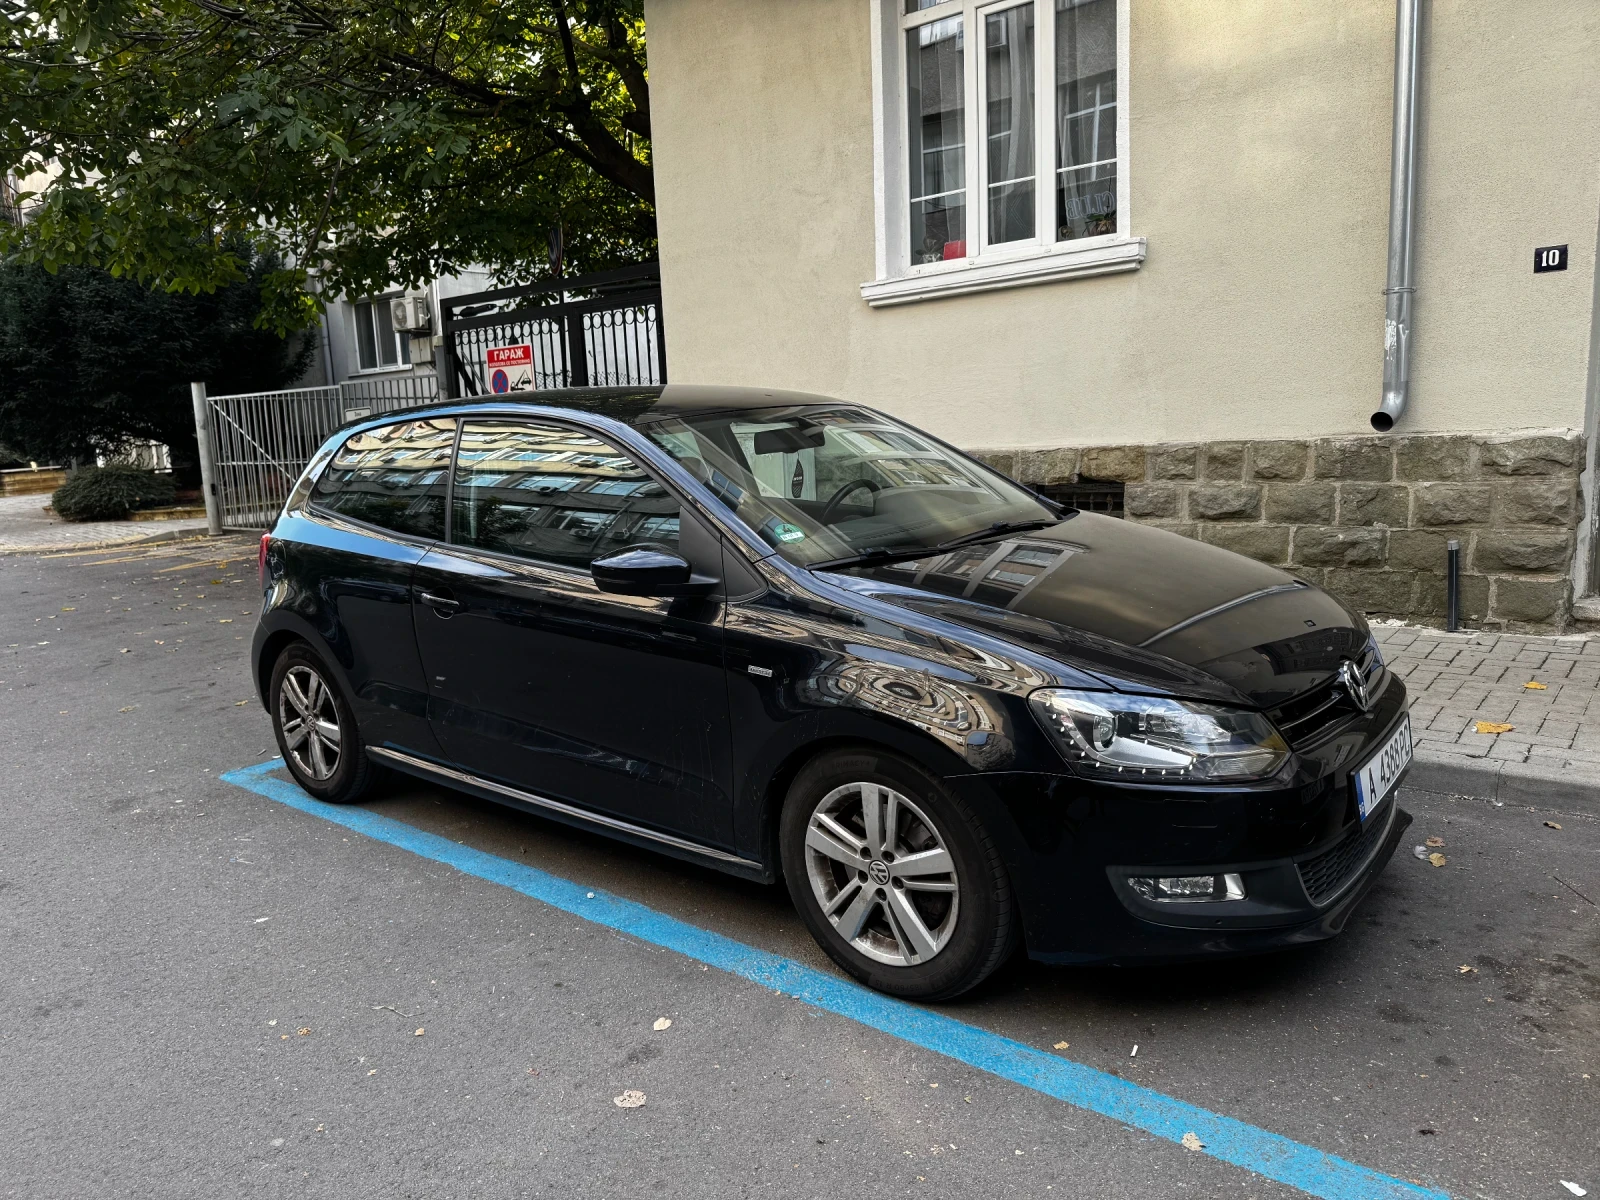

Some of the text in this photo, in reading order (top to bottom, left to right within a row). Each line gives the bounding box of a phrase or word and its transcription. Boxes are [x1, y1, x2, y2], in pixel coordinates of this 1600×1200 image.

[1541, 250, 1560, 267] 10
[494, 348, 524, 361] ГАРАЖ
[1368, 723, 1410, 804] A 4388 PC
